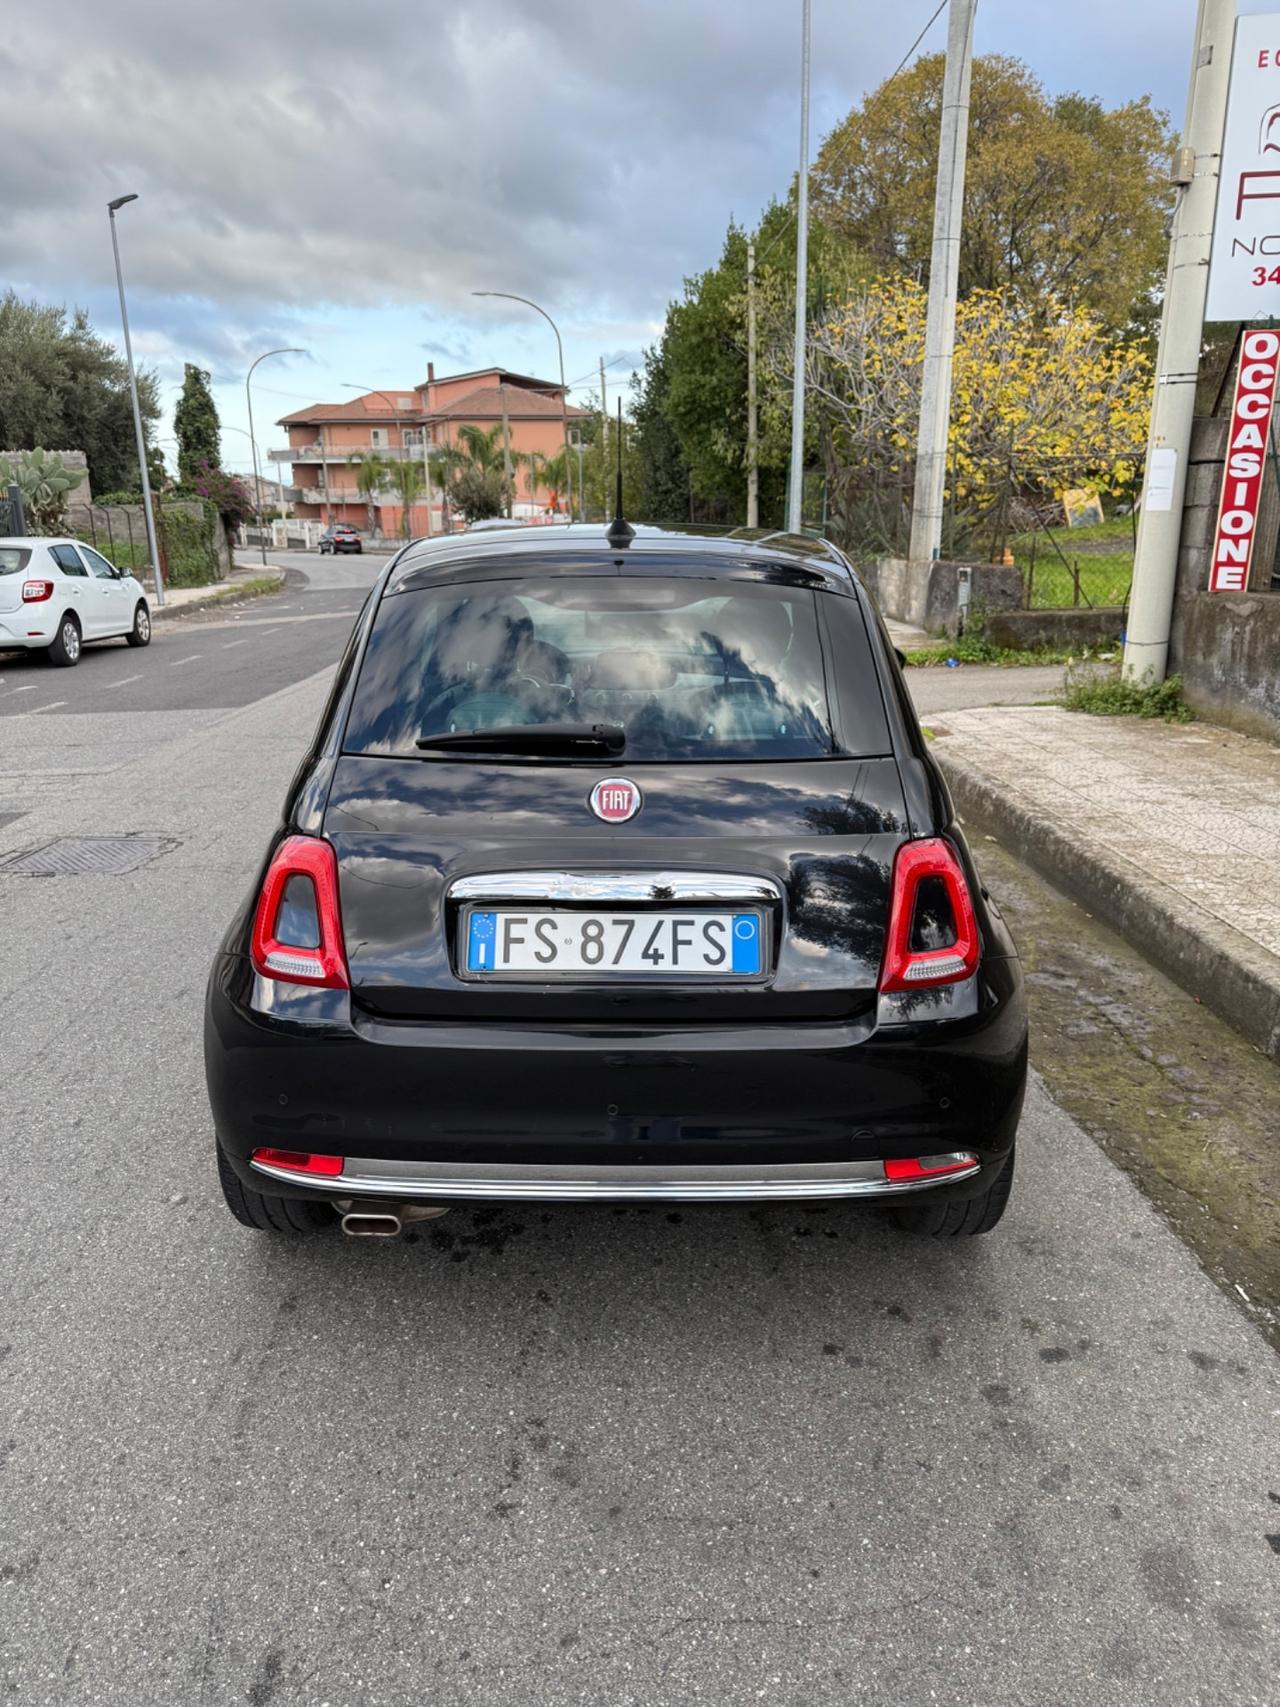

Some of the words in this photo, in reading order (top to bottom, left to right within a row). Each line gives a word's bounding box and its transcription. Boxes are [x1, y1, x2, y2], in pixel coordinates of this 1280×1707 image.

[1215, 333, 1279, 590] OCCASIONE
[602, 790, 630, 810] FIAT
[502, 917, 558, 963] FS
[580, 919, 727, 966] 874FS
